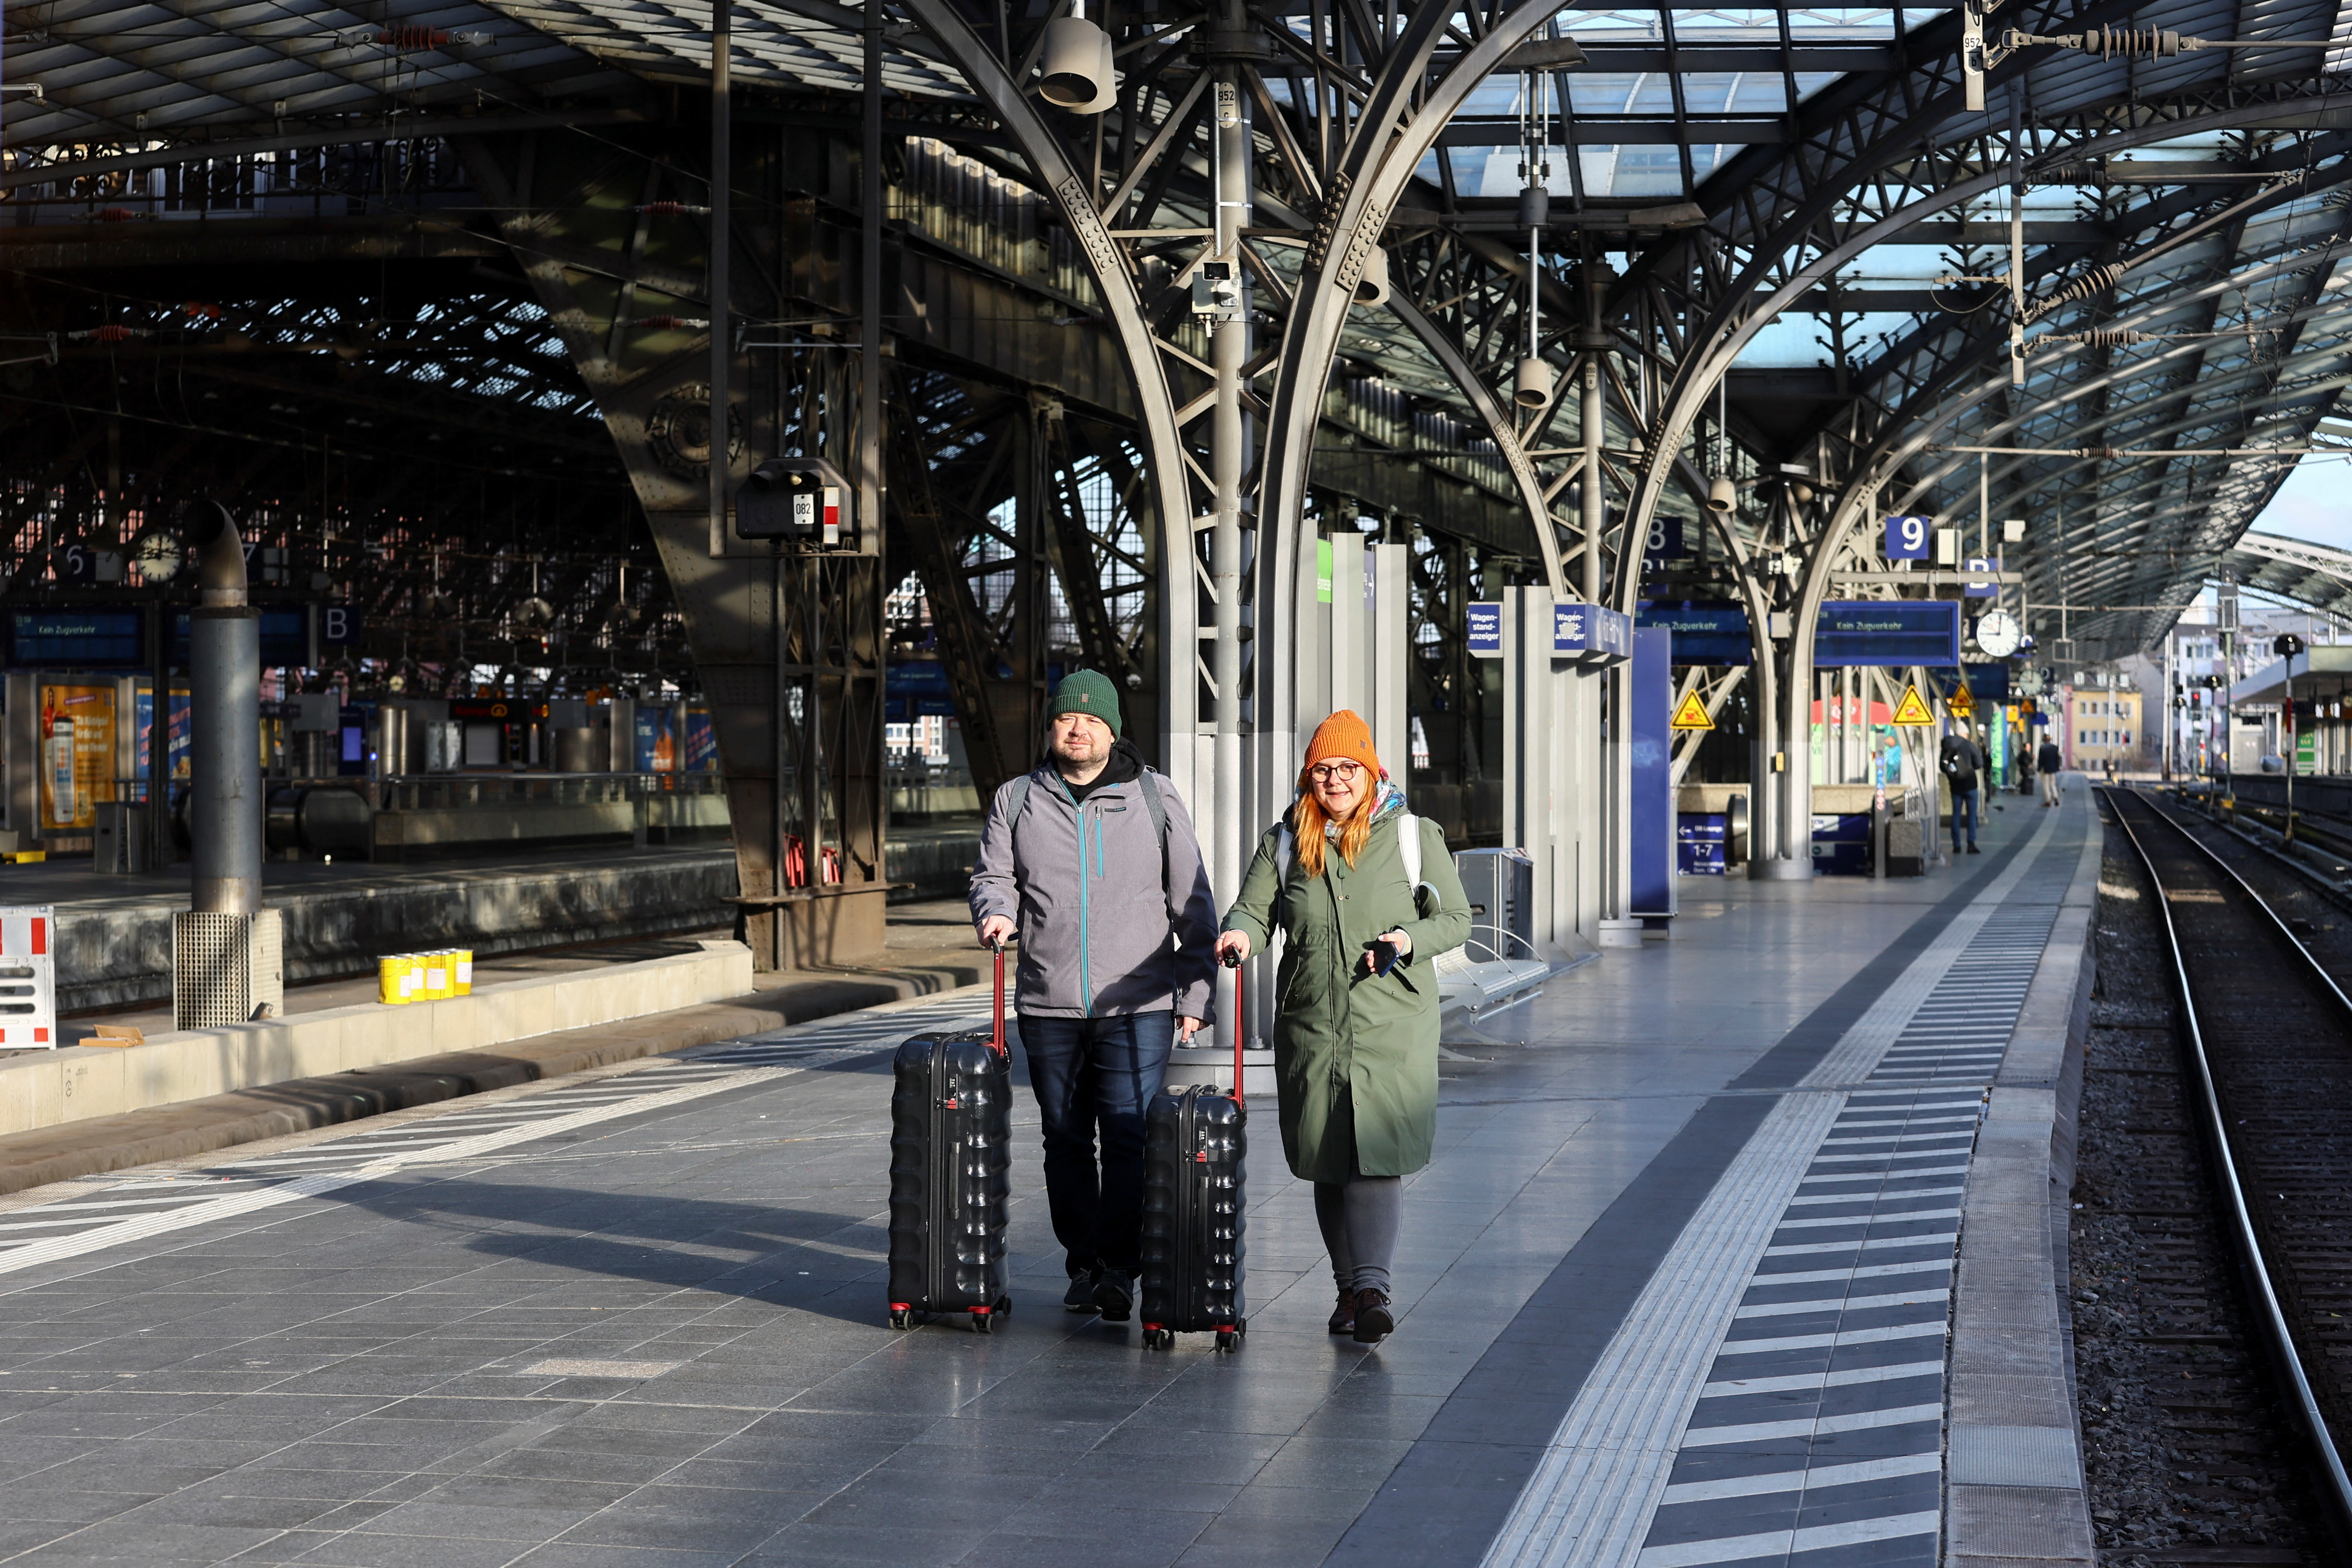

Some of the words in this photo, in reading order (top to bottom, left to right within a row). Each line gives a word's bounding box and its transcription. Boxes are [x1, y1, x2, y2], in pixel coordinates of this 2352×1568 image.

[1965, 38, 1980, 47] 952
[1971, 57, 1977, 66] b
[1219, 91, 1235, 101] 952
[796, 503, 811, 514] 082
[1647, 519, 1666, 550] 8
[1901, 517, 1924, 551] 9
[66, 544, 84, 575] 6
[1470, 614, 1498, 623] Wagen-
[1556, 613, 1584, 622] Wagen-
[327, 608, 347, 639] B
[1672, 621, 1717, 632] Zugverkehr
[1836, 621, 1854, 630] Kein
[1856, 621, 1902, 631] Zugverkehr
[38, 625, 54, 634] Kein
[56, 625, 96, 636] Zugverkehr
[1469, 632, 1499, 641] anzeiger
[1693, 844, 1714, 857] 1-7
